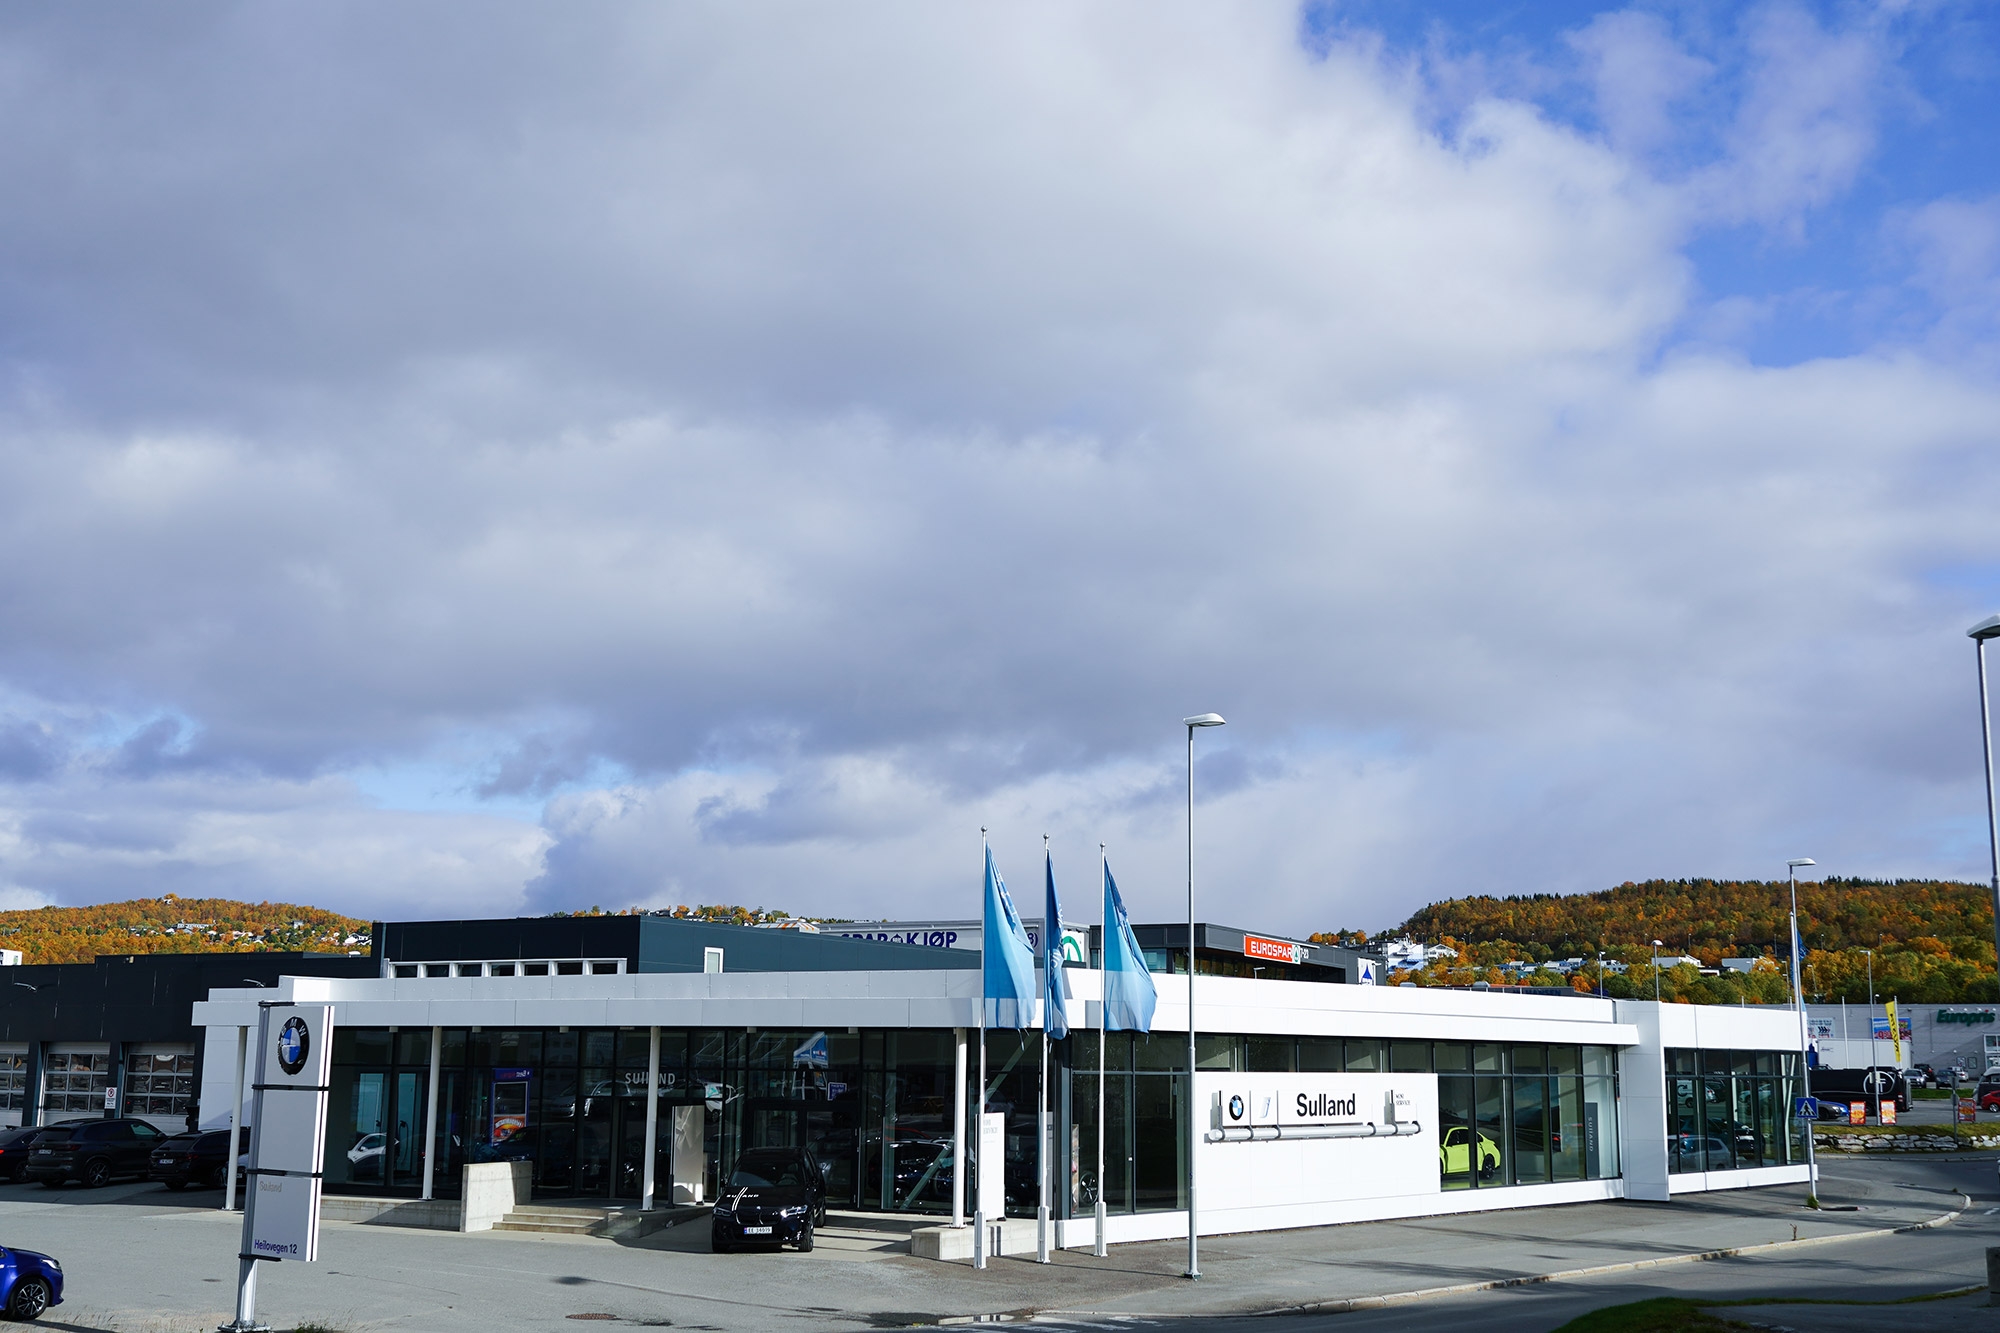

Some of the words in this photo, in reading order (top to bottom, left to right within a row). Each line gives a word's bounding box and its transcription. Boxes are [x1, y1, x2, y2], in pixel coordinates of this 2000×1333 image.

[1250, 940, 1293, 959] EUROSPAR
[1936, 1009, 1996, 1027] Europris
[1296, 1093, 1356, 1117] Sulland
[289, 1243, 298, 1255] 12
